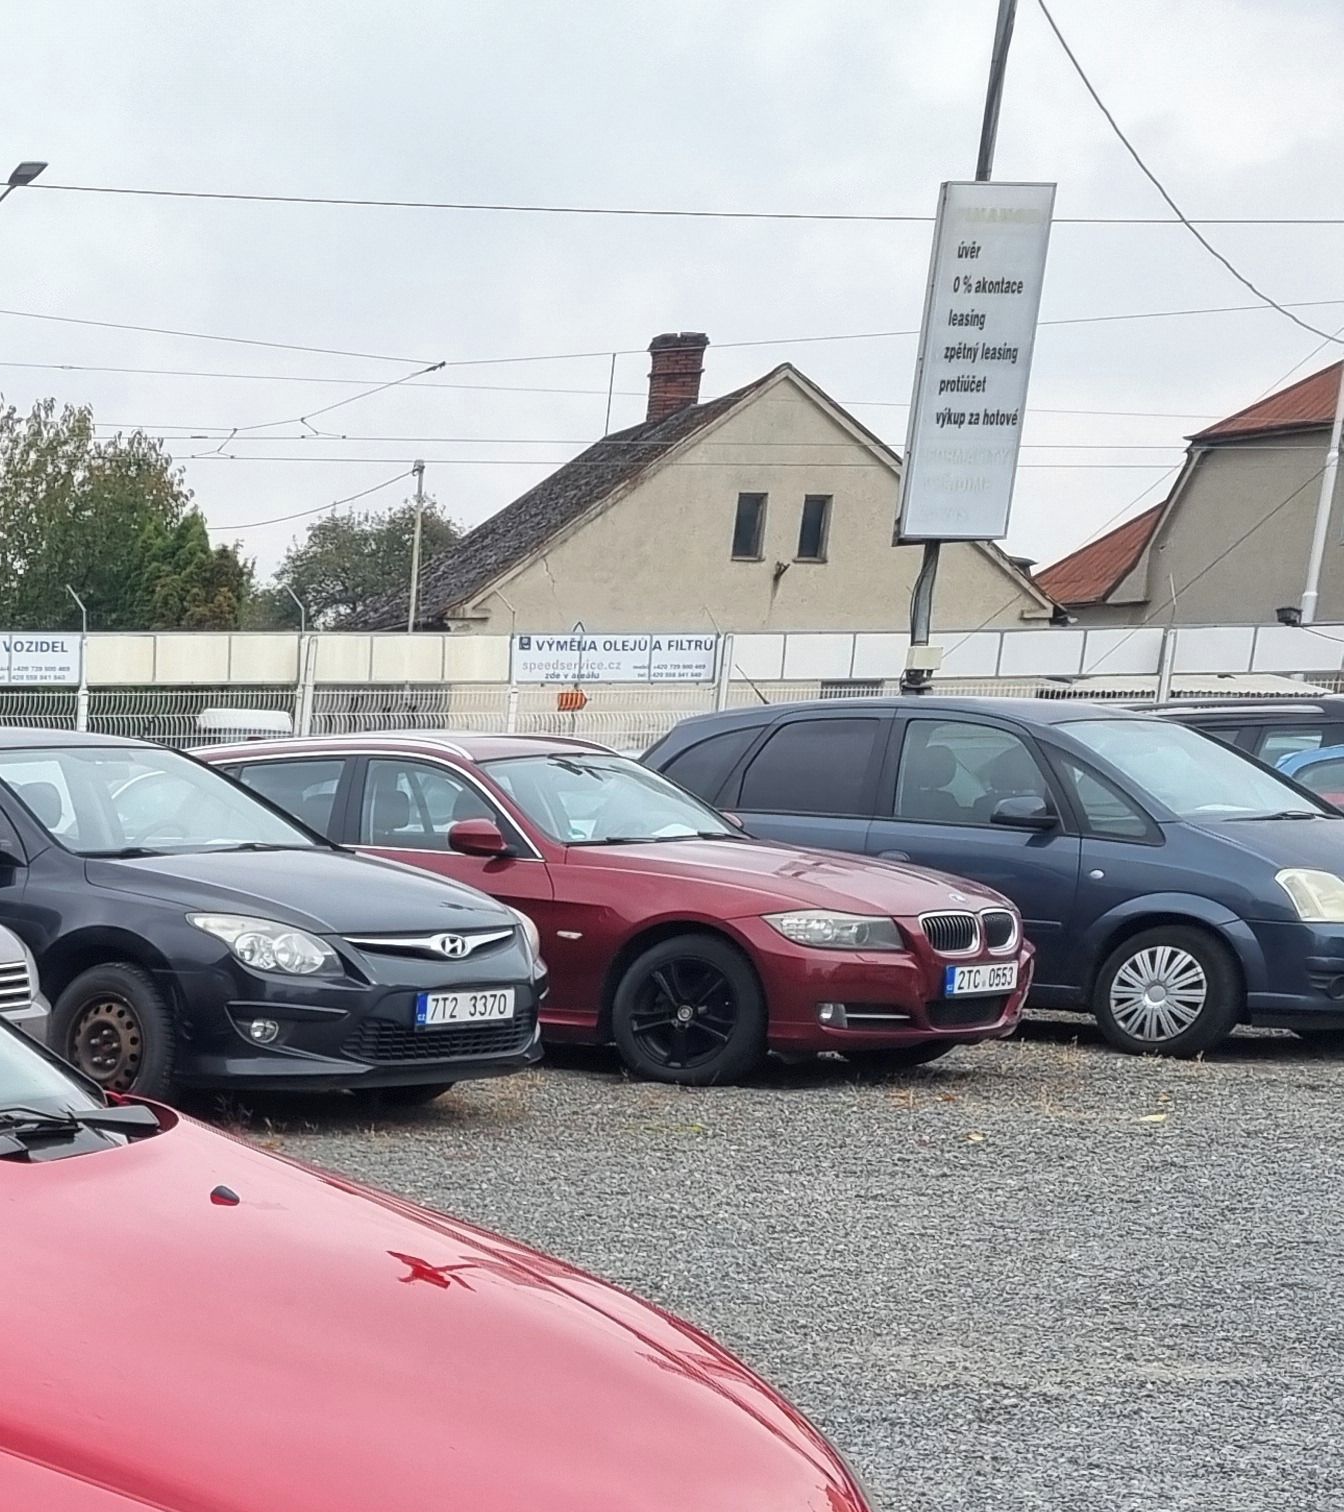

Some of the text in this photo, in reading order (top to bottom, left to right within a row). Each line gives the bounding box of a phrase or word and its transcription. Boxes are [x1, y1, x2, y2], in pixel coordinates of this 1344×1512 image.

[957, 241, 982, 259] úvěr
[953, 275, 1024, 294] 0 % akontace
[948, 309, 986, 331] leasing
[943, 342, 1019, 364] zpětný leasing
[938, 375, 987, 395] protiúčet
[935, 407, 1019, 429] výkup za hotové
[3, 640, 69, 653] VOZIDEL
[536, 637, 713, 652] VÝMĚNA OLEJŮ A FILTRŮ
[957, 966, 1014, 991] 2TC 0553
[430, 993, 507, 1020] 7T2 3370
